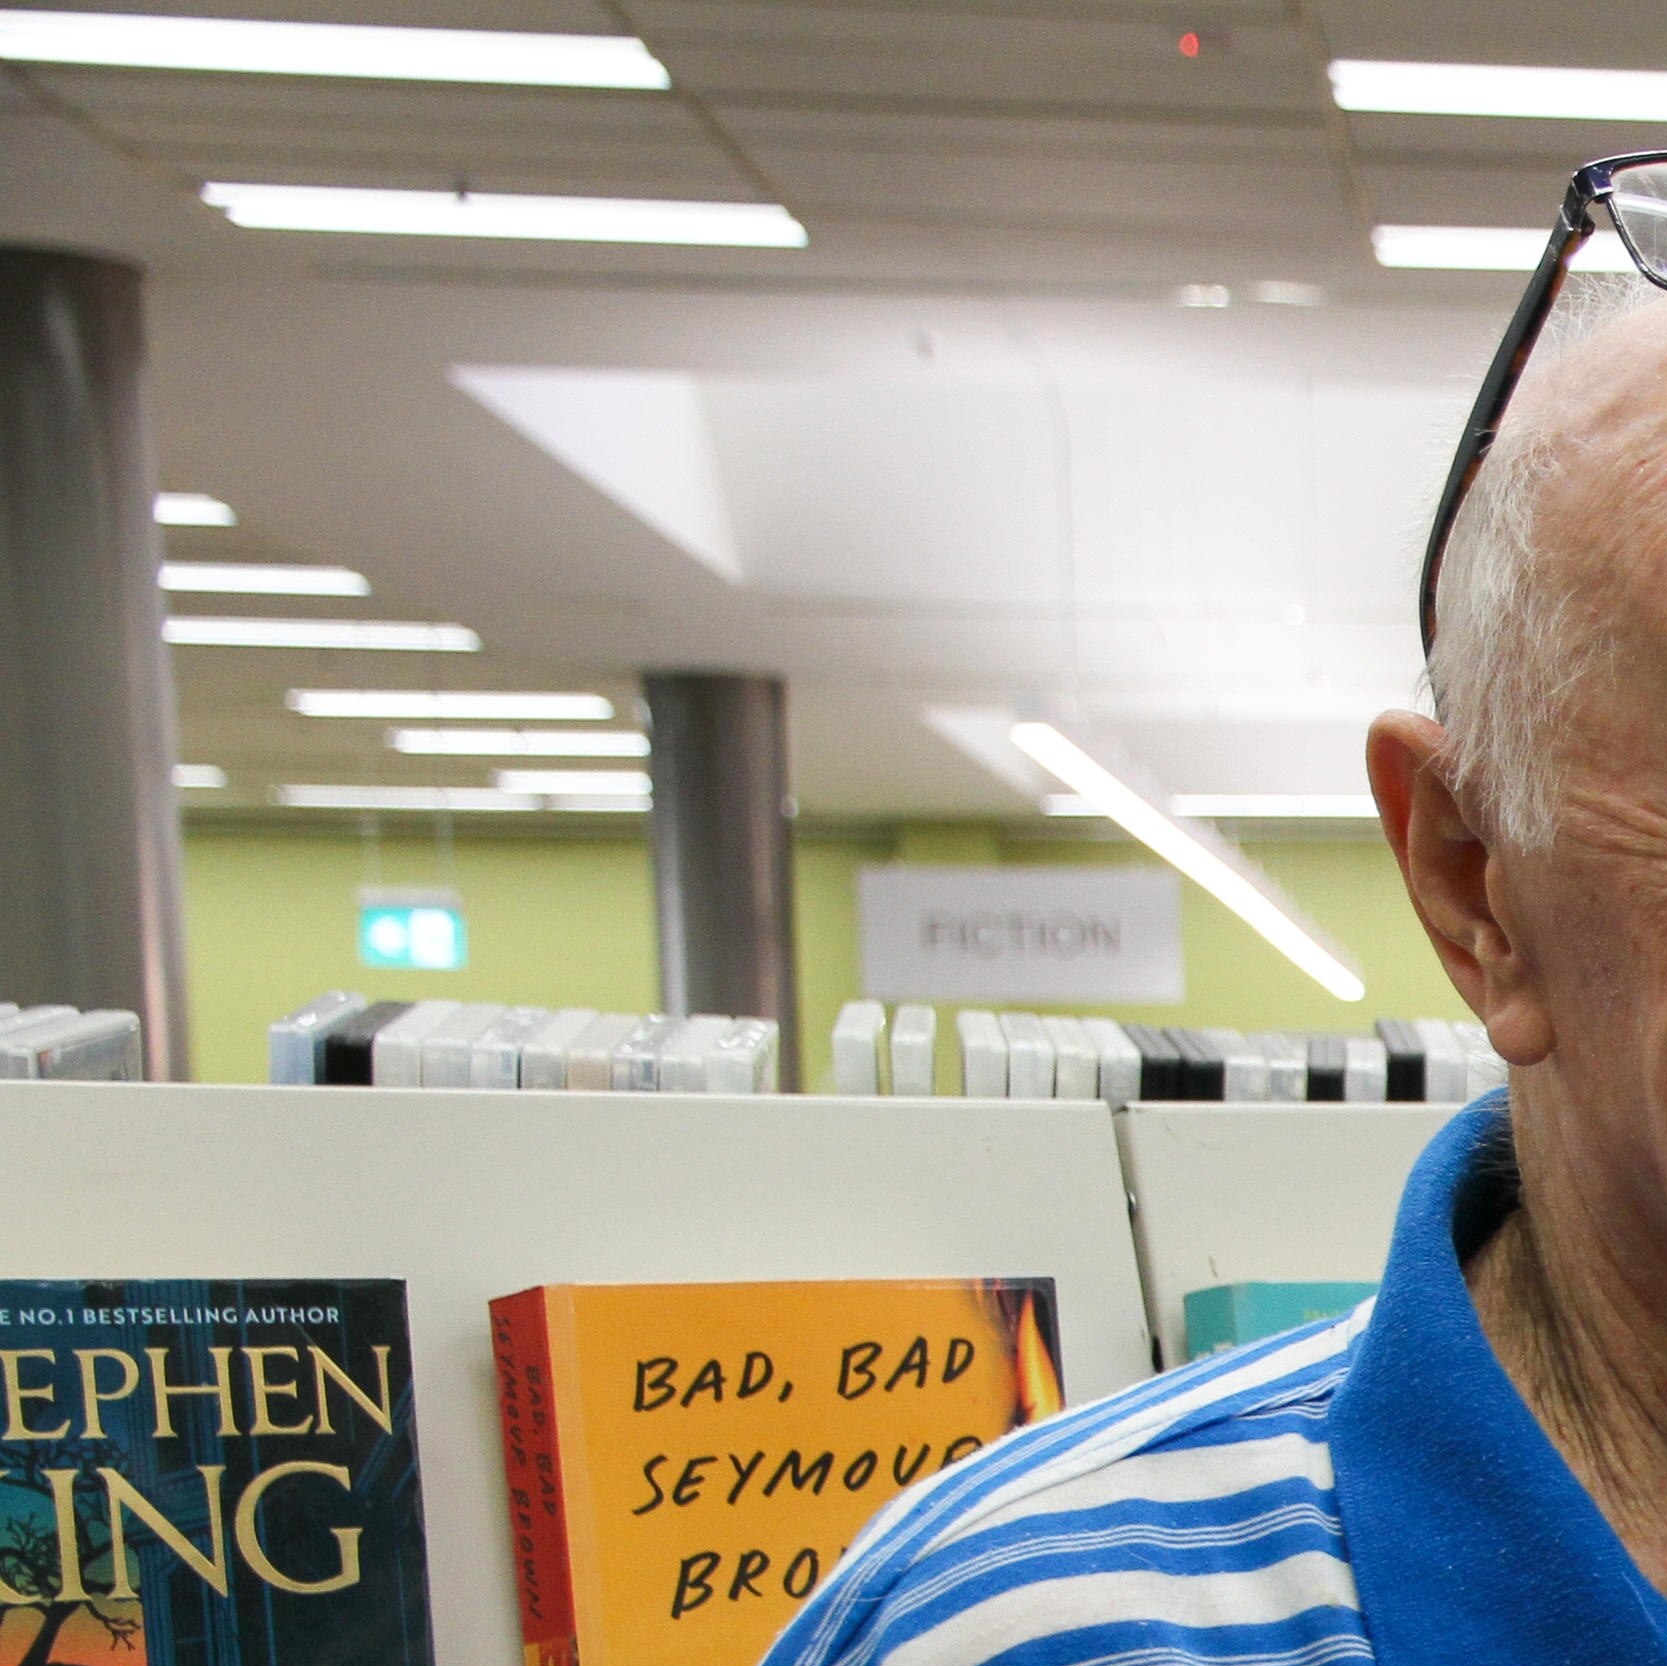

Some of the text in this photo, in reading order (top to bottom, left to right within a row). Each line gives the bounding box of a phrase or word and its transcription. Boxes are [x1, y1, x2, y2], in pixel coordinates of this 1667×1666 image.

[921, 909, 1121, 960] FICTION
[20, 1308, 74, 1325] NO.1
[83, 1308, 238, 1325] BESTSELLING
[245, 1307, 339, 1325] AUTHOR
[0, 1345, 393, 1440] EPHEN
[633, 1336, 975, 1412] BAD, BAD
[497, 1316, 544, 1621] SEYMOUR BROWN
[536, 1453, 558, 1518] BAD
[0, 1460, 363, 1604] ING
[671, 1547, 848, 1620] BRO
